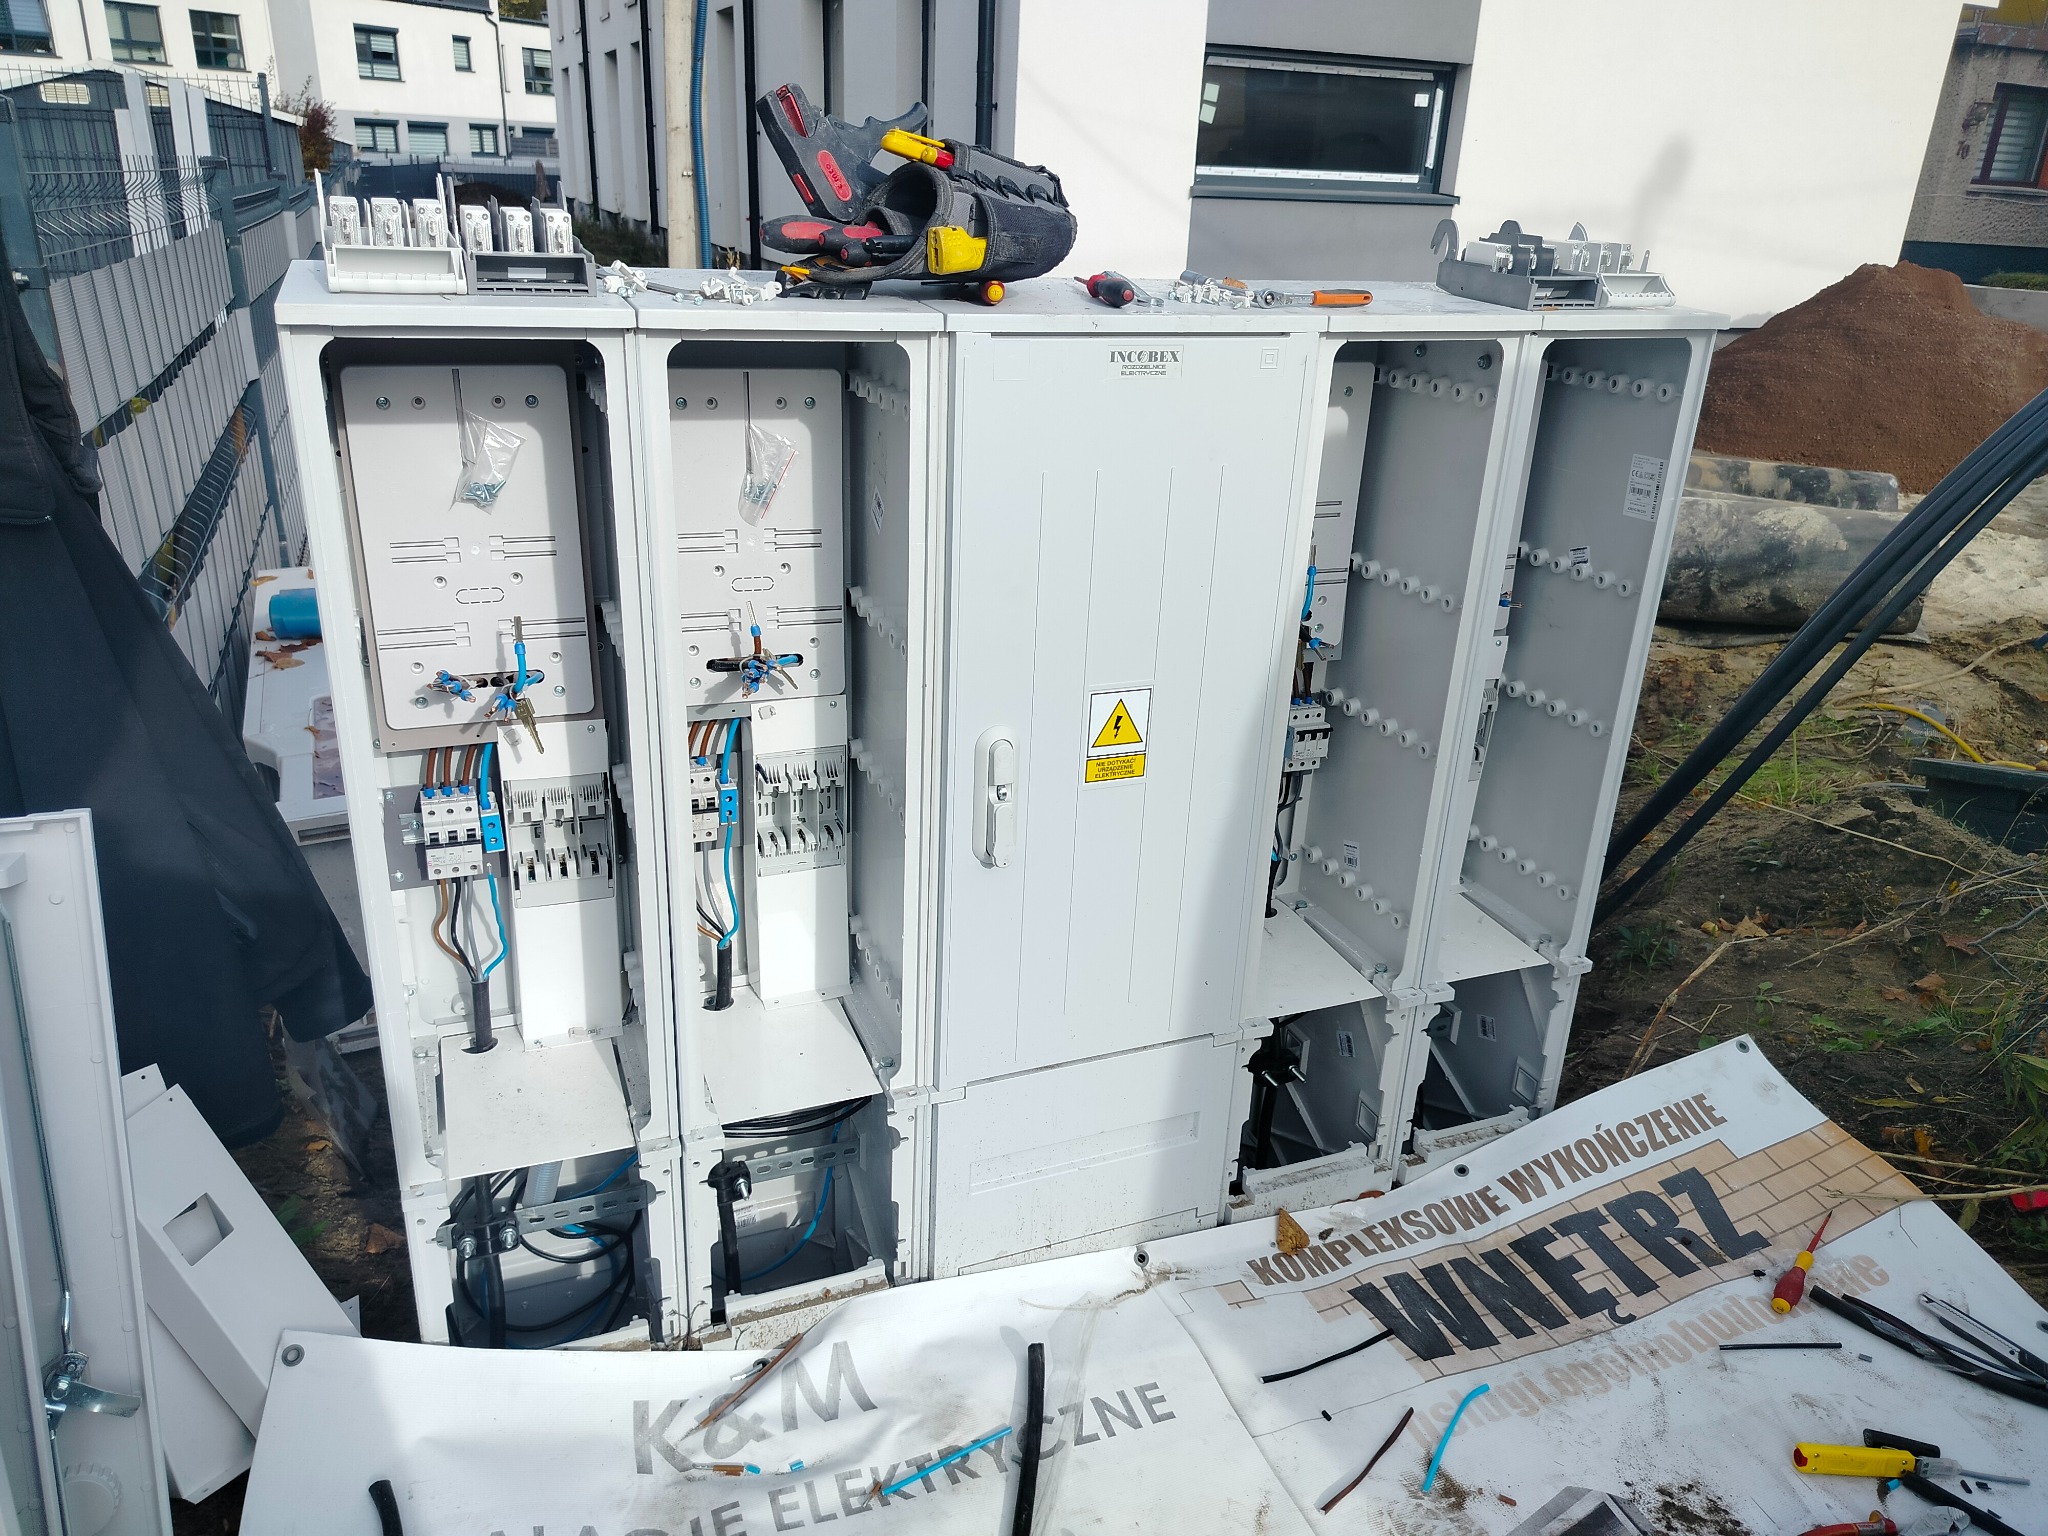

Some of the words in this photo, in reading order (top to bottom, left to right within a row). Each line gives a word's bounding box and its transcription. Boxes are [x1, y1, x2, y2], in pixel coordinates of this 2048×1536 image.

[1109, 350, 1180, 363] INCOBEX
[1095, 769, 1135, 778] ELEKTRYCZNE
[1098, 764, 1133, 773] URZĄDZENIE
[1245, 1184, 1512, 1286] KOMPLEKSOWE
[1495, 1092, 1729, 1206] WYKOŃCZENIE
[1346, 1166, 1773, 1361] WNĘTRZ
[632, 1340, 879, 1475] K&M
[767, 1381, 1177, 1533] ELEKTRYCZNE
